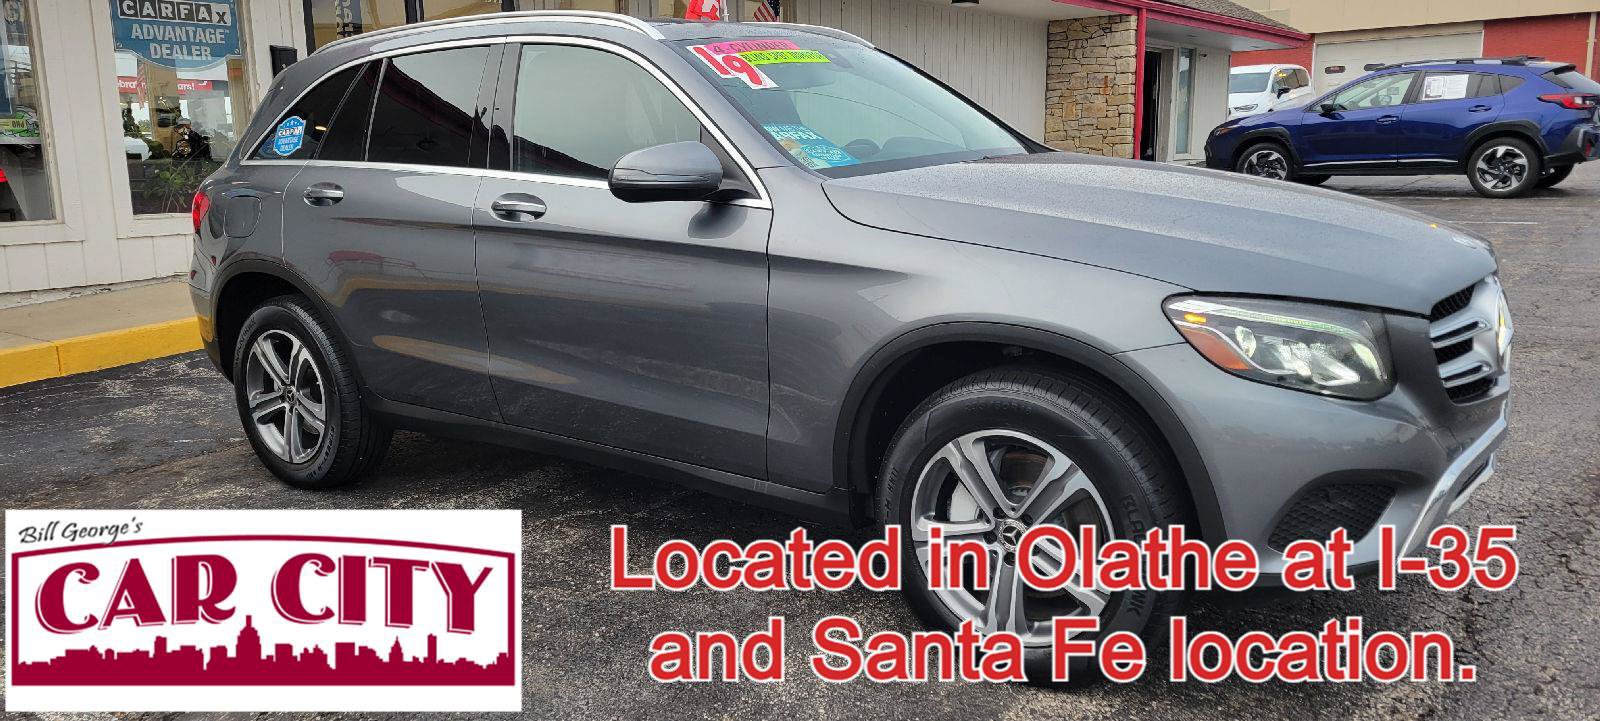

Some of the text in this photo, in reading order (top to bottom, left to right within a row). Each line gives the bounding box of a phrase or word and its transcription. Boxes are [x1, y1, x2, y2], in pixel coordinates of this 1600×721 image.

[121, 0, 229, 25] CARFAX
[131, 23, 226, 44] ADVANTAGE
[149, 43, 212, 61] DEALER
[692, 46, 763, 86] 19
